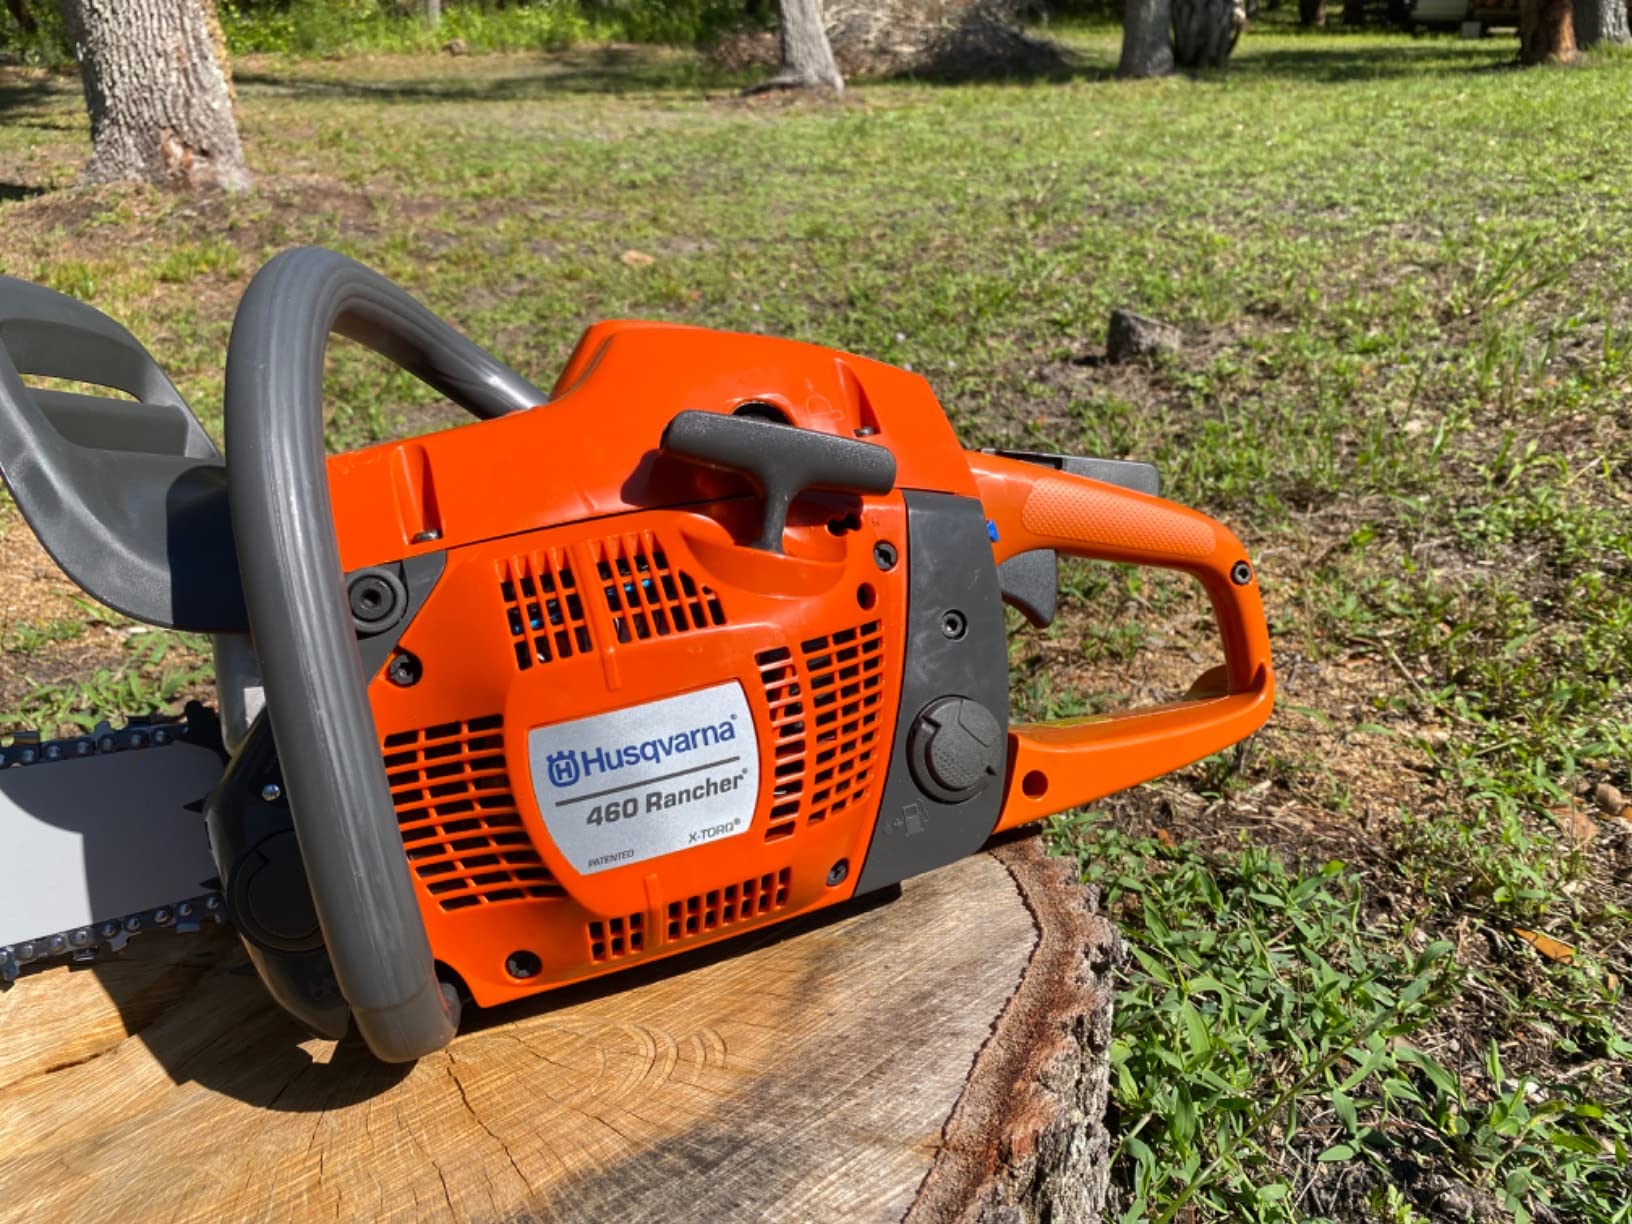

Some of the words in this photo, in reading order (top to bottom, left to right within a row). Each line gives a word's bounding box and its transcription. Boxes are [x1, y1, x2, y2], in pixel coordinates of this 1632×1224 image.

[581, 720, 736, 776] Husqvarna
[586, 798, 638, 826] 460
[645, 775, 744, 813] Rancher
[588, 849, 634, 868] PATENTED
